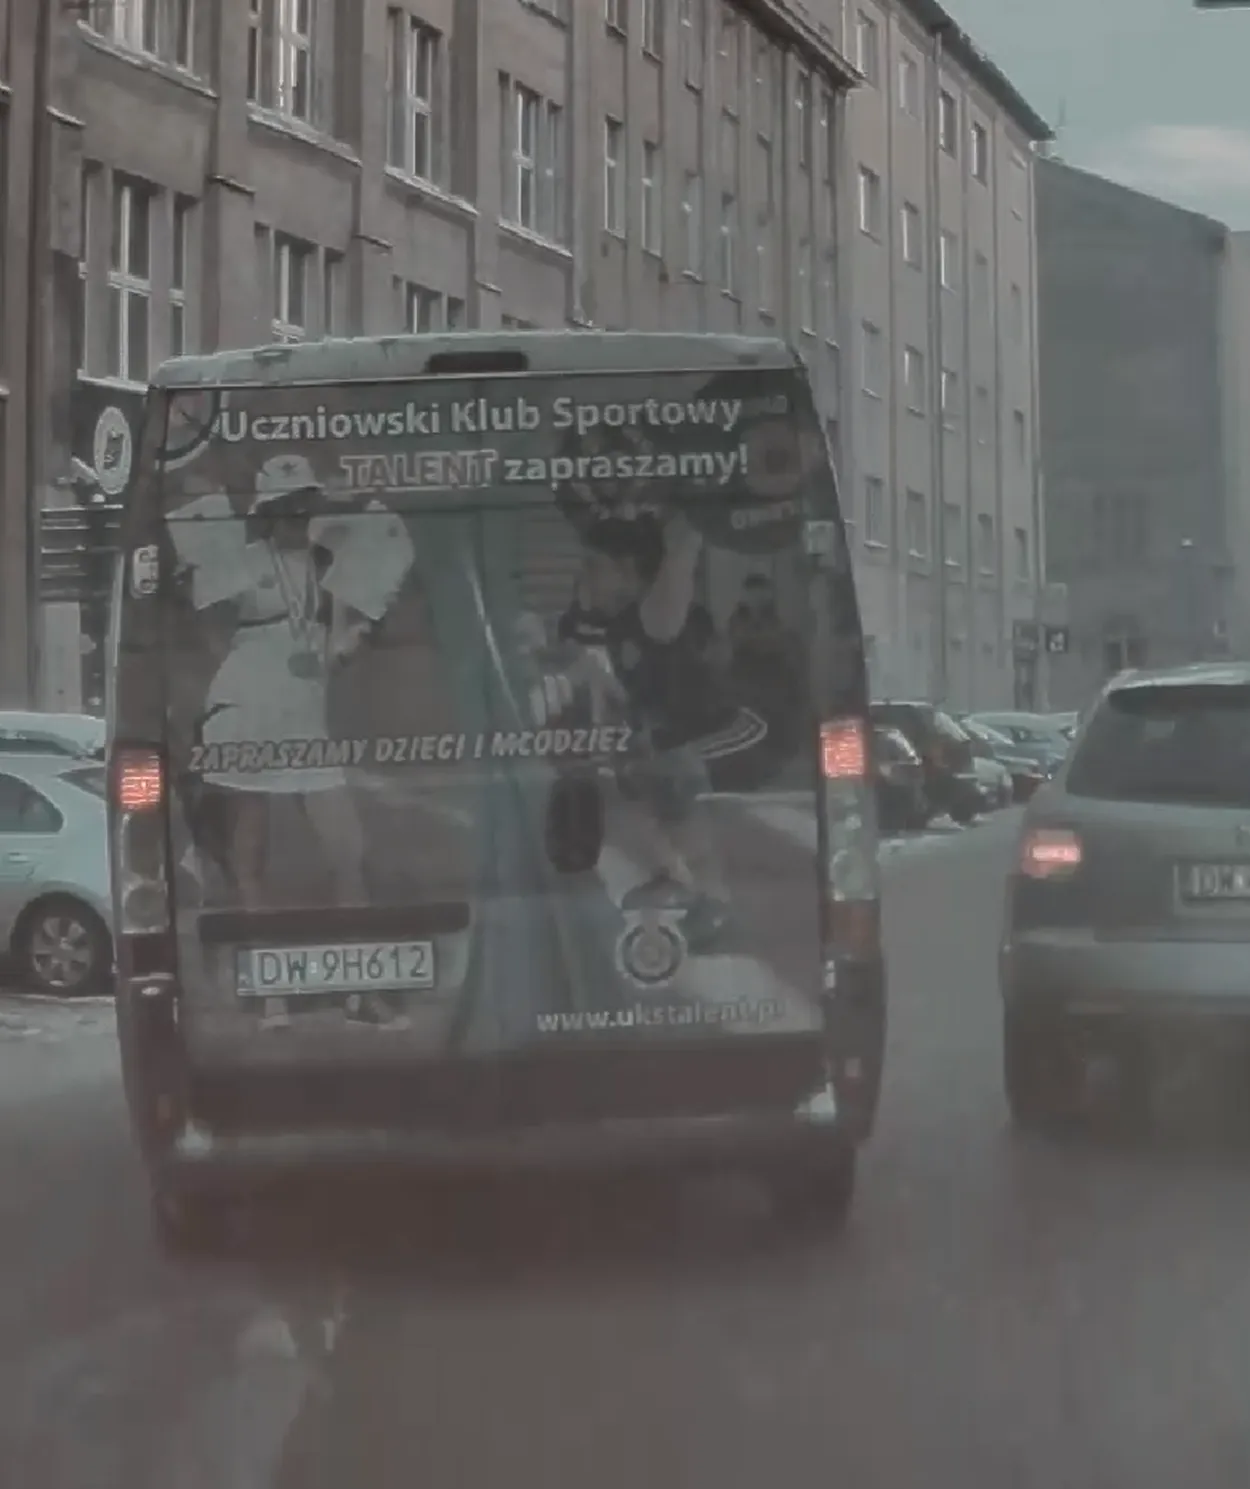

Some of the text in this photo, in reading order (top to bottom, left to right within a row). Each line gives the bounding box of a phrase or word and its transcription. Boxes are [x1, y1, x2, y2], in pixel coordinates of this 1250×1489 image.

[220, 402, 440, 443] Uczniowski
[450, 397, 539, 434] Klub
[553, 395, 744, 434] Sportowy
[339, 444, 750, 491] TALENT zapraszamy!
[187, 737, 368, 773] ZAPRASZAMY
[375, 732, 465, 763] DZIECI
[472, 732, 484, 759] I
[258, 945, 430, 985] DW 9H612
